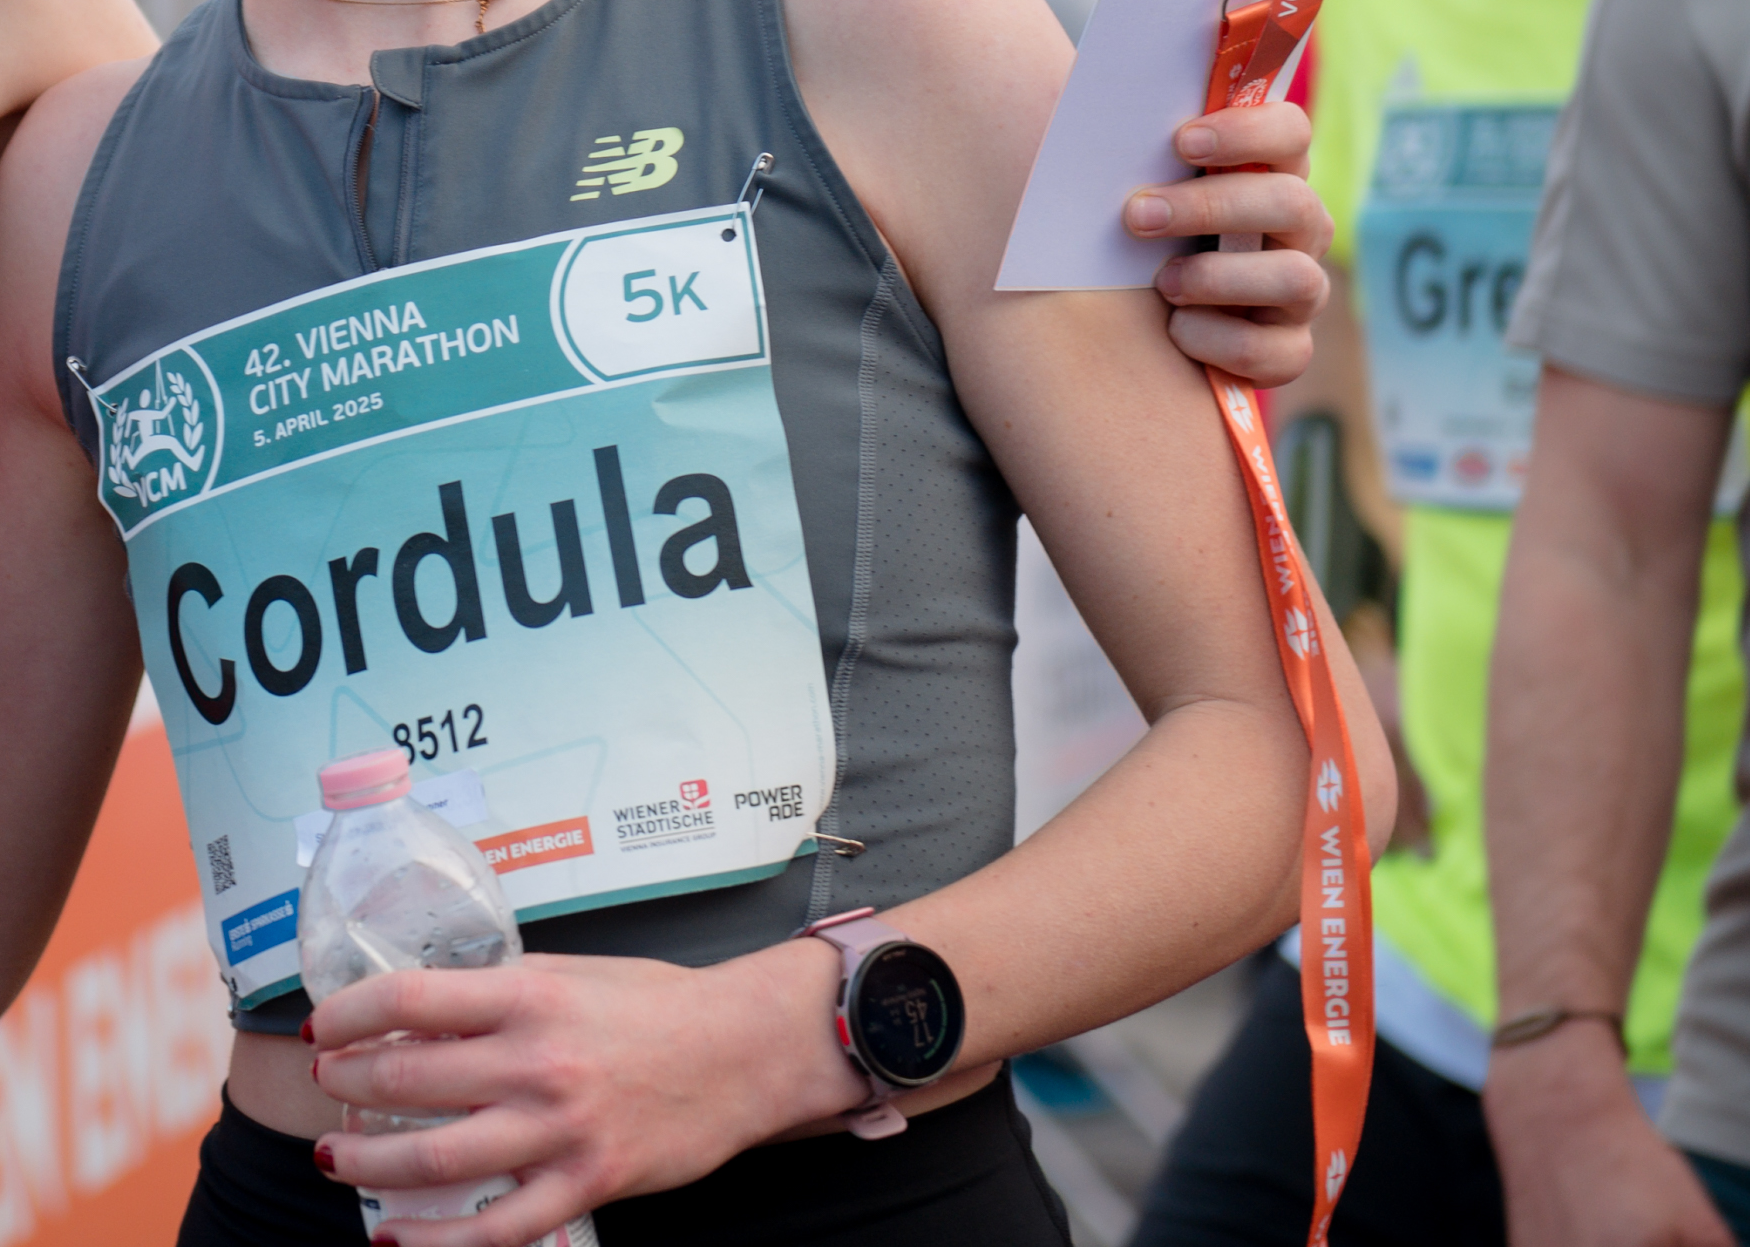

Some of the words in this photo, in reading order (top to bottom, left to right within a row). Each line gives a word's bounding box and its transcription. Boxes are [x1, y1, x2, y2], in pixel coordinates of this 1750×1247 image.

[623, 269, 709, 322] 5K
[244, 343, 291, 377] 42.
[295, 301, 427, 359] VIENNA
[250, 367, 312, 415] CITY
[321, 314, 520, 391] MARATHON
[253, 429, 271, 447] 5.
[275, 409, 329, 440] APRIL
[332, 392, 384, 422] 2025
[133, 462, 187, 507] VCM
[167, 444, 754, 726] Cordula
[392, 703, 489, 766] 8512
[613, 800, 681, 822] WIENER
[734, 784, 803, 810] POWER
[769, 801, 804, 822] ADE
[485, 846, 508, 864] EN
[510, 829, 585, 859] ENERGIE
[1320, 826, 1345, 908] WIEN
[1322, 918, 1352, 1046] ENERGIE
